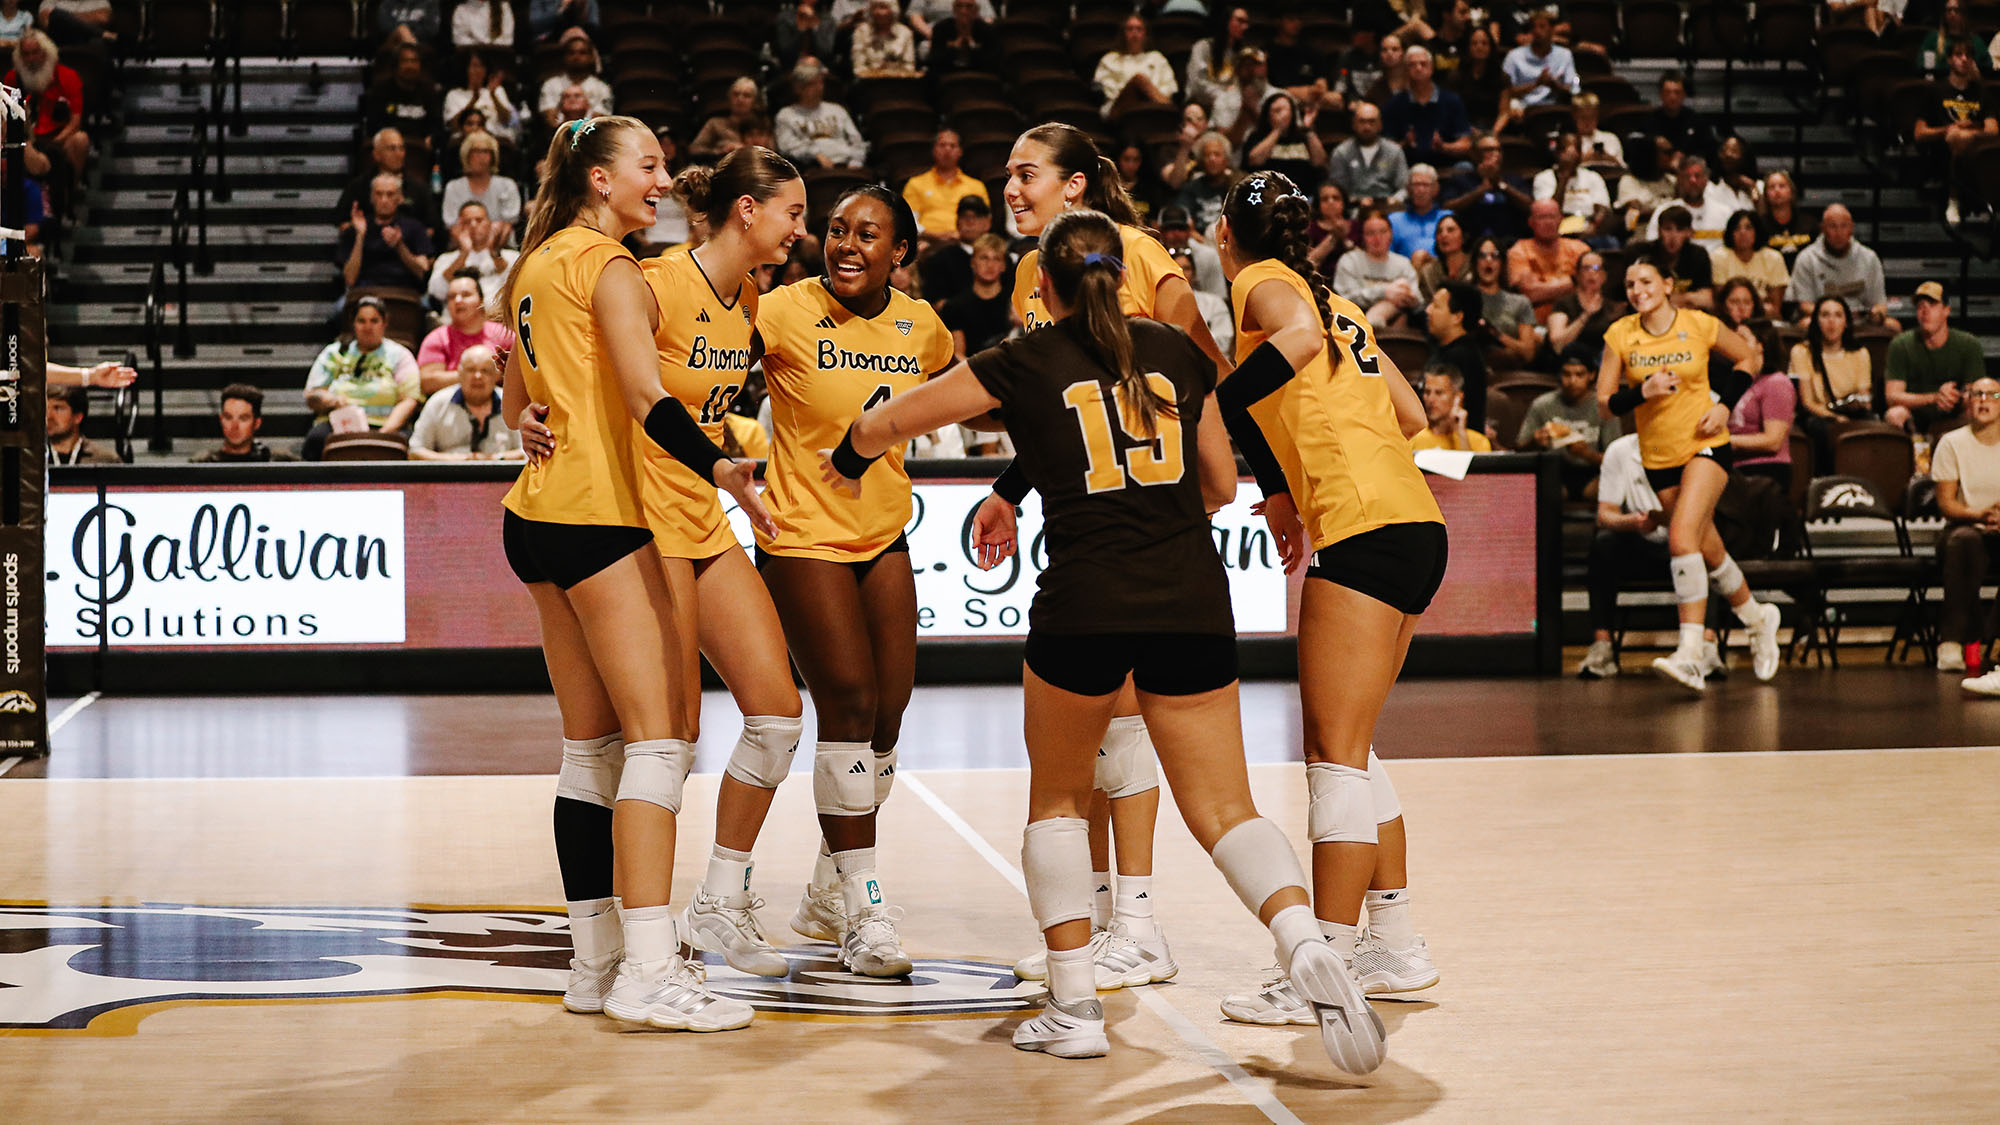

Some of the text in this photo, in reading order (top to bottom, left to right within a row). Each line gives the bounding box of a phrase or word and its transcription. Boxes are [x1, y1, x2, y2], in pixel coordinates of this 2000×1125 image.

[518, 294, 538, 371] 6
[817, 338, 921, 376] Broncos
[1334, 312, 1382, 376] 2
[1629, 351, 1693, 368] Broncos
[699, 384, 741, 424] 10
[1062, 372, 1185, 494] 19
[72, 503, 392, 605] Gallivan
[3, 552, 21, 674] sports imports
[76, 607, 319, 637] Solutions
